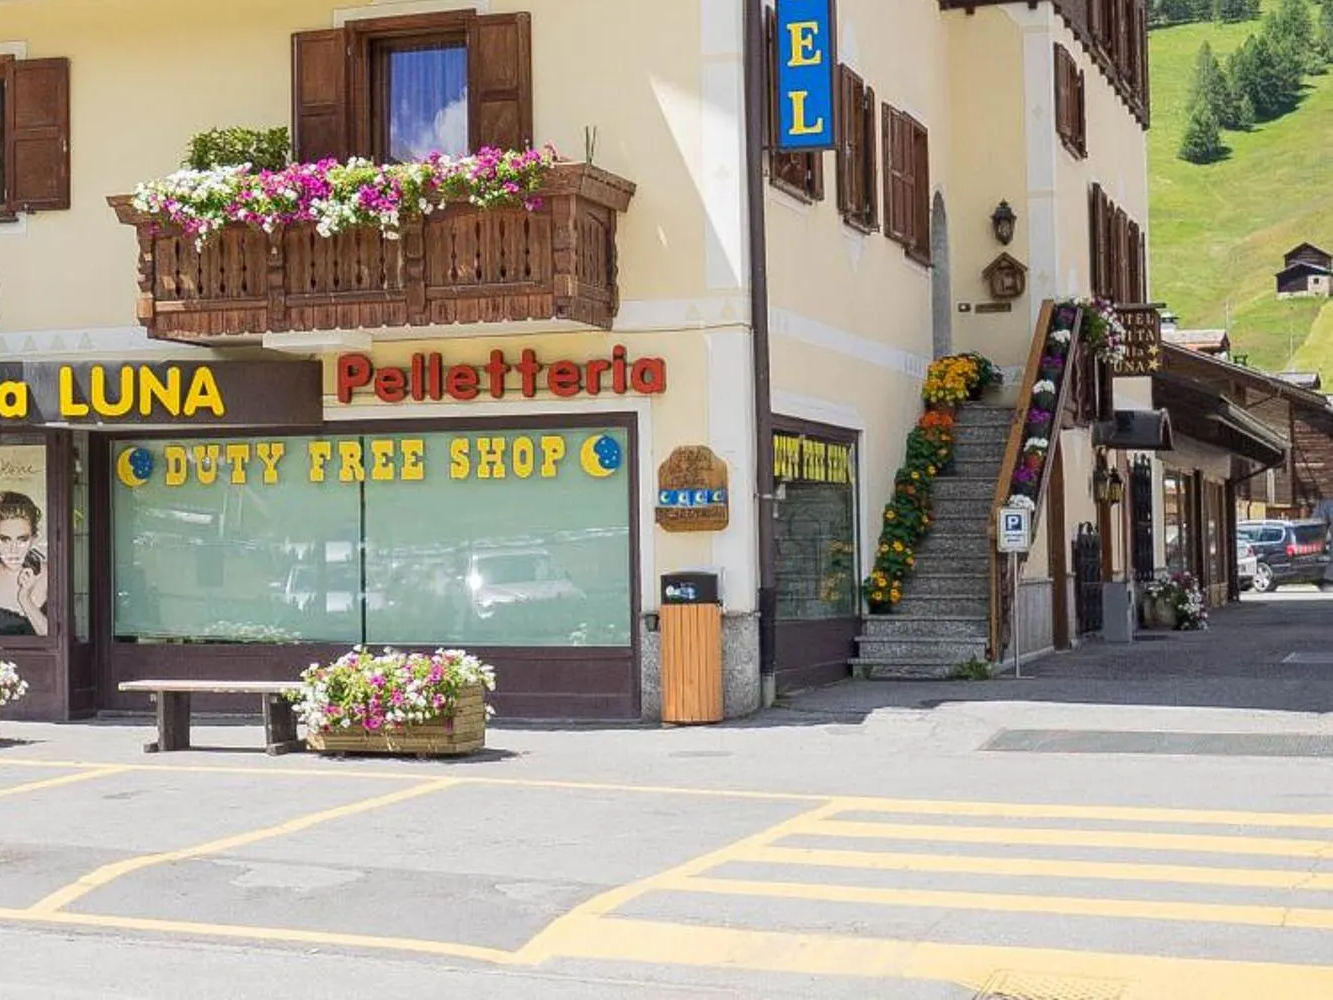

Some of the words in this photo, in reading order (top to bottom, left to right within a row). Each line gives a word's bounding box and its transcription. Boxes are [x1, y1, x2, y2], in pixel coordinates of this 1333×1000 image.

[59, 365, 225, 418] LUNA
[336, 344, 667, 404] Pelletteria
[164, 442, 285, 486] DUTY
[308, 439, 426, 483] FREE
[449, 436, 565, 480] SHOP
